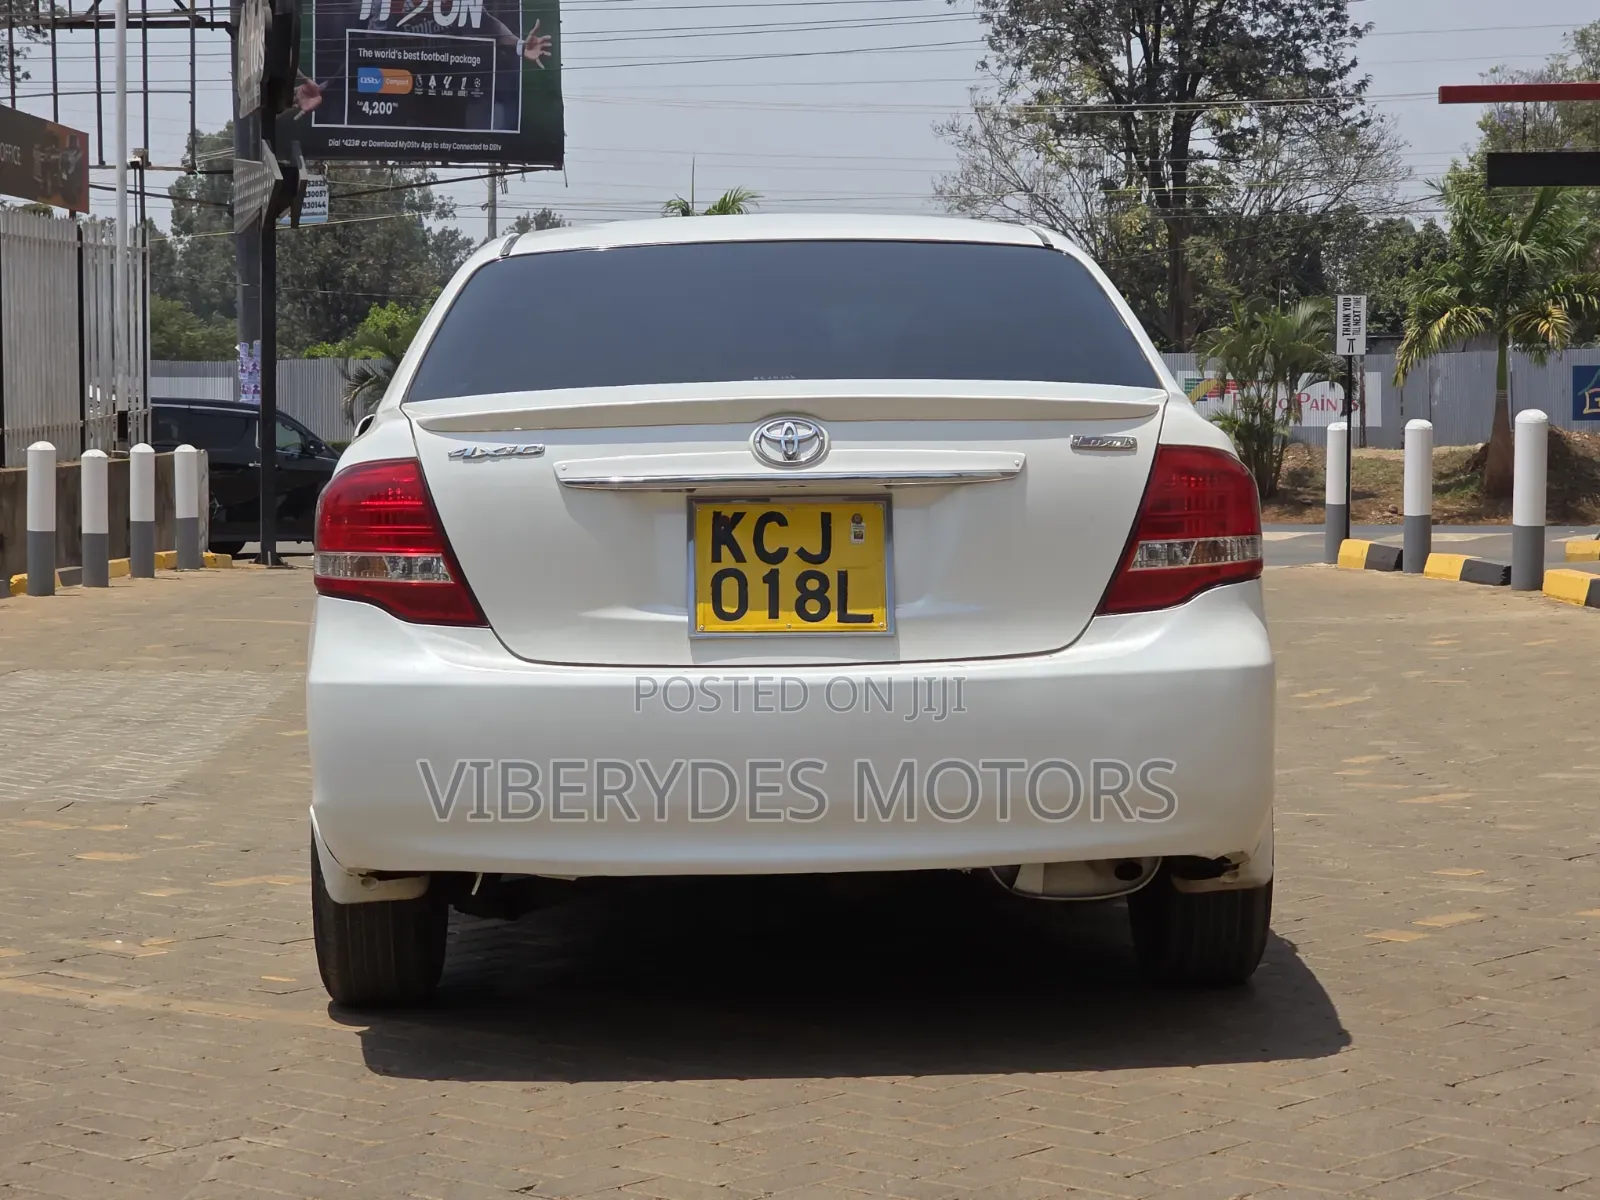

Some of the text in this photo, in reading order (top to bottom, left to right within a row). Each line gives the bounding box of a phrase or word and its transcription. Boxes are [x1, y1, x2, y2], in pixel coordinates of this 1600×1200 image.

[358, 48, 481, 67] The world's best football package
[362, 101, 393, 115] 4,200
[328, 139, 341, 147] Dial
[368, 140, 398, 148] Download
[399, 140, 420, 150] MyDStv
[421, 141, 432, 150] App
[440, 142, 452, 151] stay
[452, 142, 482, 150] Connected
[1342, 297, 1352, 336] THANK YOU
[1352, 296, 1361, 336] TILL NEXT TIME
[711, 511, 832, 565] KCJ
[710, 567, 875, 623] 018L
